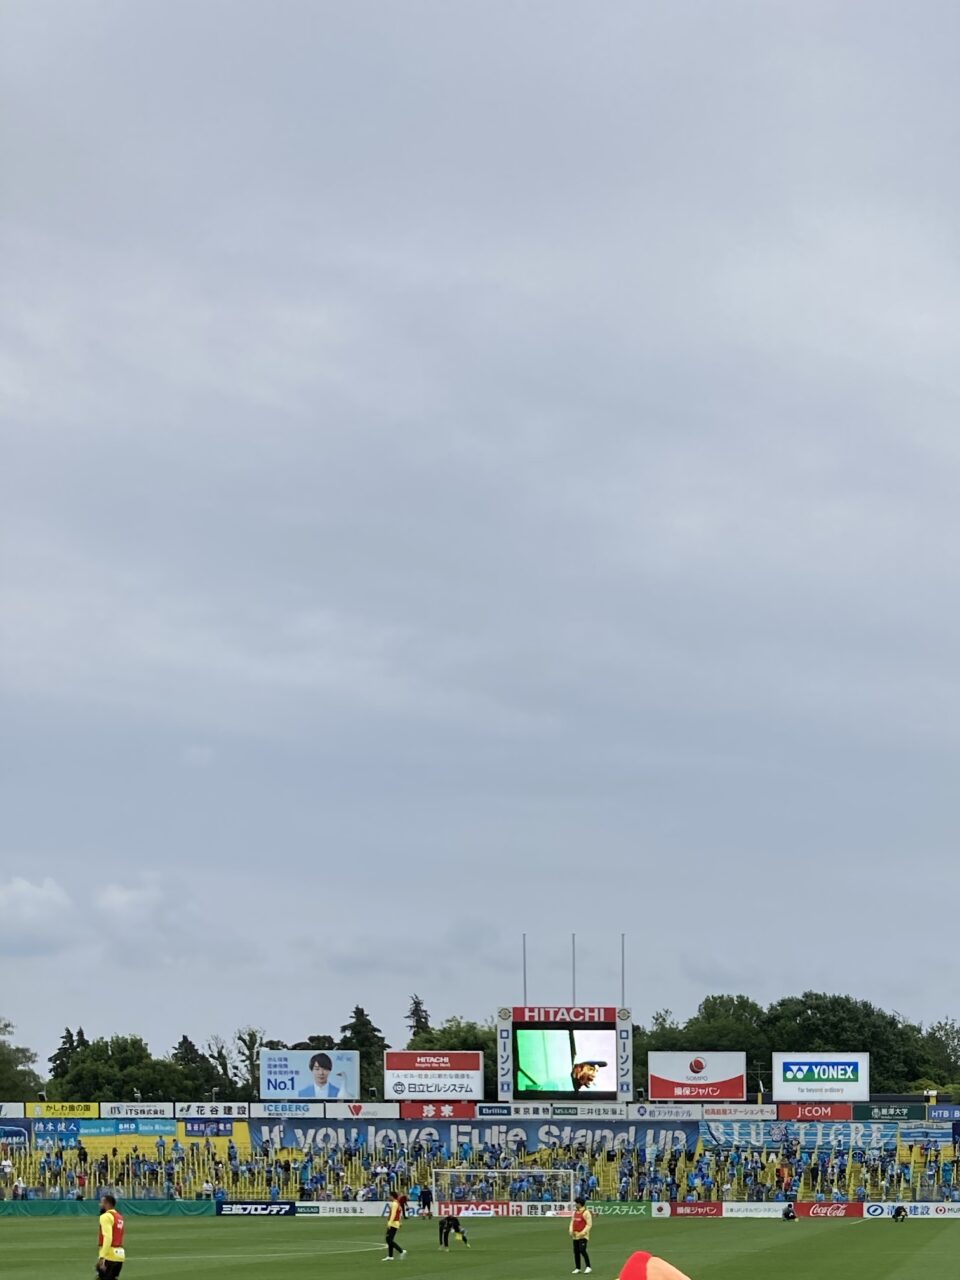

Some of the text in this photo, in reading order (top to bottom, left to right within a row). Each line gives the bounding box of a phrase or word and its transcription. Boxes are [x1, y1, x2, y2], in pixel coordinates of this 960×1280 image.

[524, 1008, 605, 1021] HITACHI
[499, 1029, 510, 1077] ローソン
[619, 1029, 630, 1077] ローソン
[811, 1065, 854, 1079] YONEX
[267, 1077, 295, 1091] No.1
[408, 1083, 473, 1093] 日立ビルシステム
[673, 1086, 721, 1096] 損保ジャパン
[195, 1105, 247, 1115] 花谷建設
[263, 1104, 310, 1112] ICEBERG
[513, 1107, 550, 1115] 東京建物
[579, 1107, 625, 1116] 三井住友海上
[797, 1106, 831, 1117] J:COM
[931, 1110, 949, 1118] HTB
[294, 1127, 358, 1150] you
[367, 1125, 440, 1152] love
[537, 1124, 636, 1150] Stand
[321, 1206, 365, 1214] 三井住友海上
[441, 1203, 508, 1216] HITACHI
[676, 1206, 717, 1214] 損保ジャパン
[809, 1203, 848, 1217] Coca-Cola
[886, 1204, 930, 1216] 清建設
